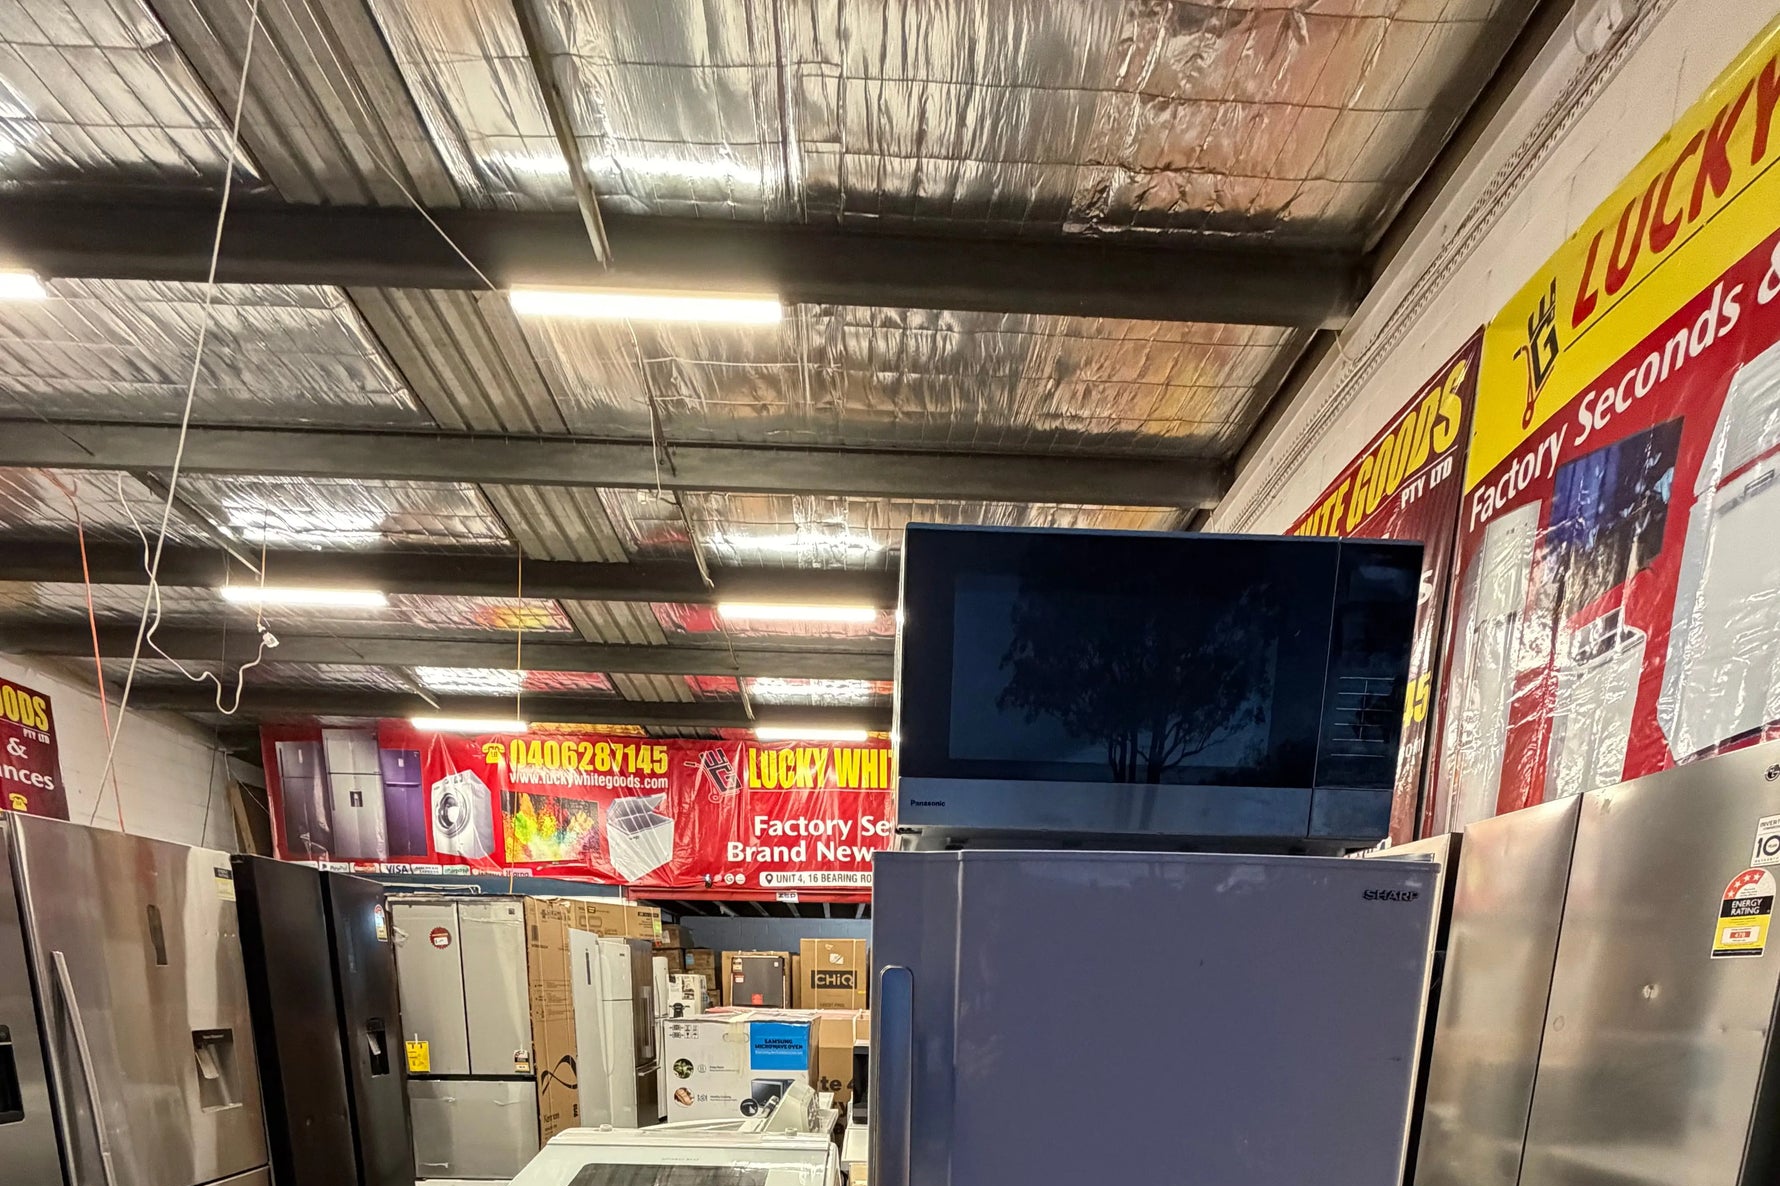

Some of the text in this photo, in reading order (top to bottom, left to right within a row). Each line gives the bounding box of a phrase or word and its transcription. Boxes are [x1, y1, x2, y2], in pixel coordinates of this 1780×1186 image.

[1572, 54, 1780, 329] LUCKY
[1469, 422, 1568, 533] Factory
[1574, 280, 1744, 446] Seconds
[1345, 359, 1467, 533] GOODS
[1401, 456, 1452, 510] PTY LTD
[0, 685, 48, 731] ODS
[7, 737, 28, 759] &
[509, 739, 669, 774] 0406287145
[749, 748, 829, 789] LUCKY
[833, 748, 891, 789] WHI
[509, 771, 668, 790] www.luckywhitegoods.com
[910, 799, 946, 807] Panasonic
[754, 815, 853, 840] Factory
[727, 840, 874, 863] Brand New
[1756, 835, 1780, 858] 10
[386, 864, 408, 874] VISA
[776, 874, 796, 884] UNIT
[809, 874, 819, 884] 16
[821, 873, 858, 884] BEARING
[860, 873, 872, 884] RO
[1363, 889, 1420, 902] SHARP
[1731, 898, 1763, 909] ENERGY
[1730, 906, 1760, 916] RATING
